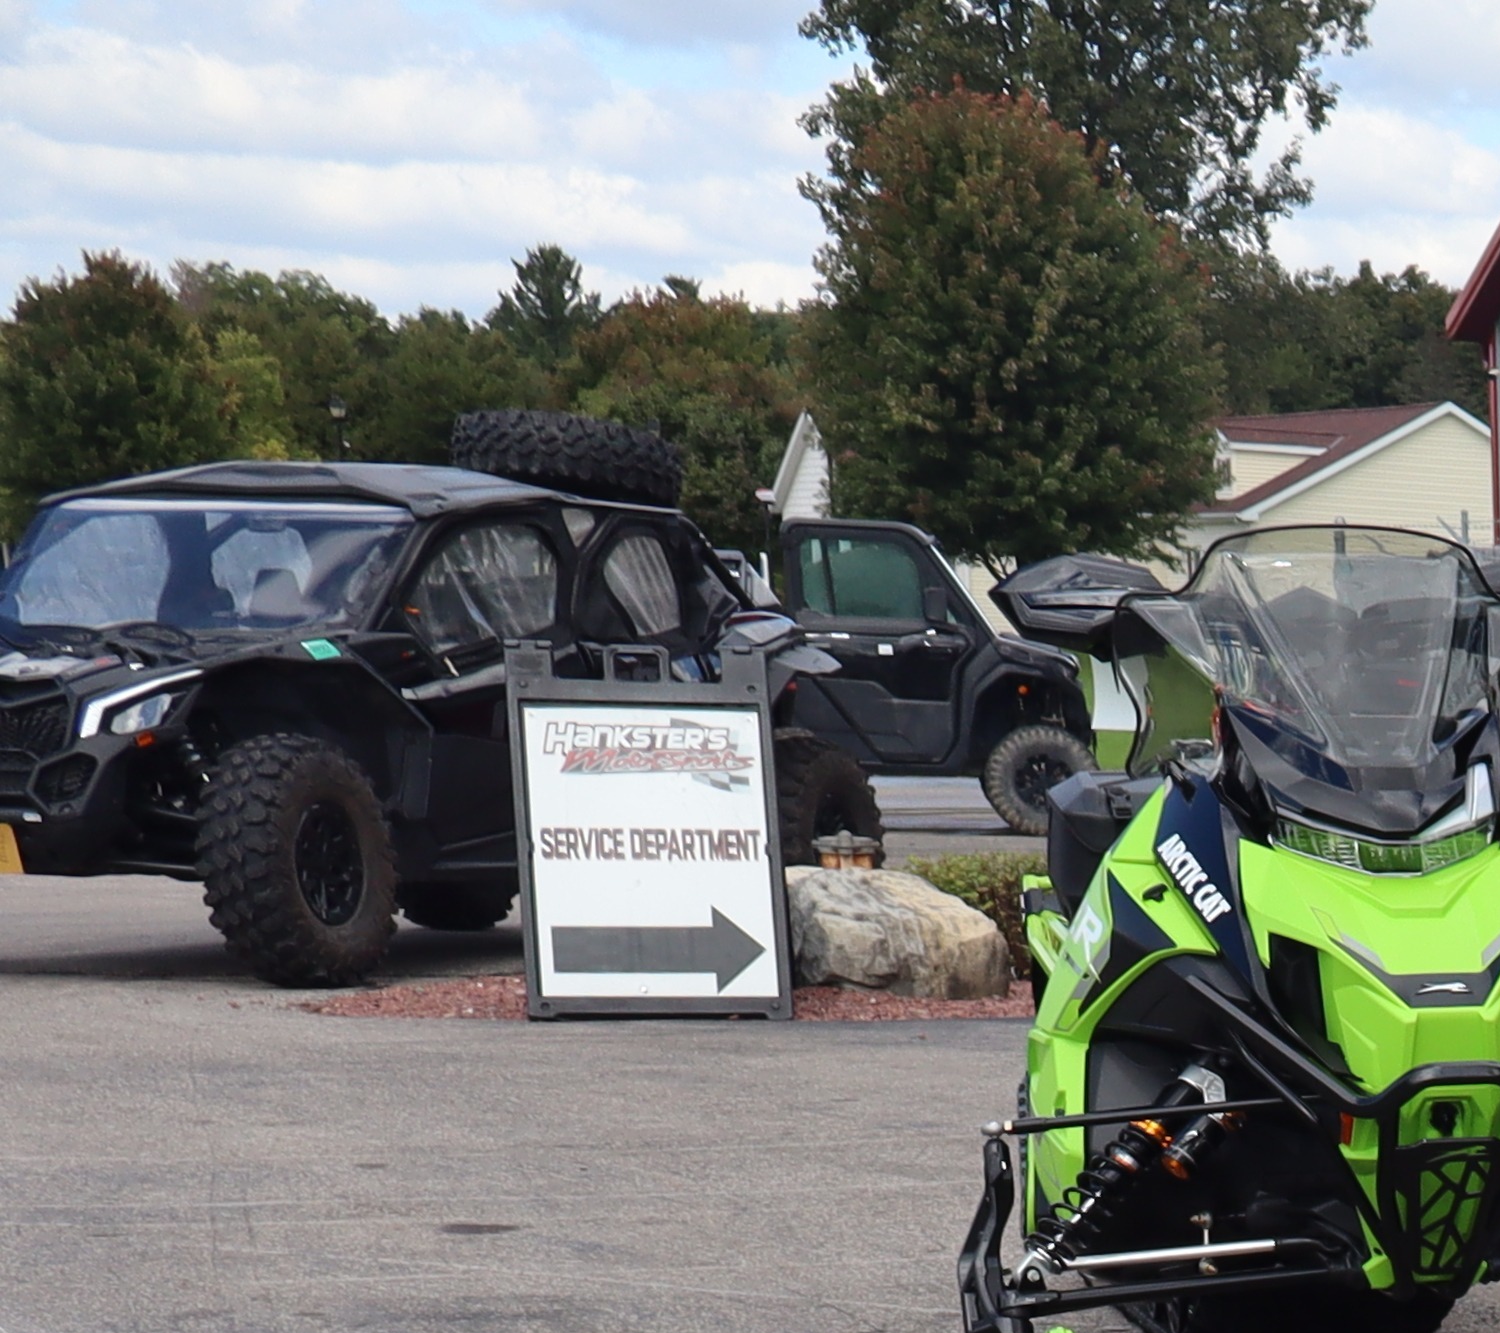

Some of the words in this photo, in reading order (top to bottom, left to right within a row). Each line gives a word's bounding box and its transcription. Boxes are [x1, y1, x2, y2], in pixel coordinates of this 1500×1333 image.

[540, 828, 625, 860] SERVICE
[630, 828, 761, 861] DEPARTMENT
[1157, 833, 1208, 895] ARCTIC
[1193, 883, 1232, 923] CAT
